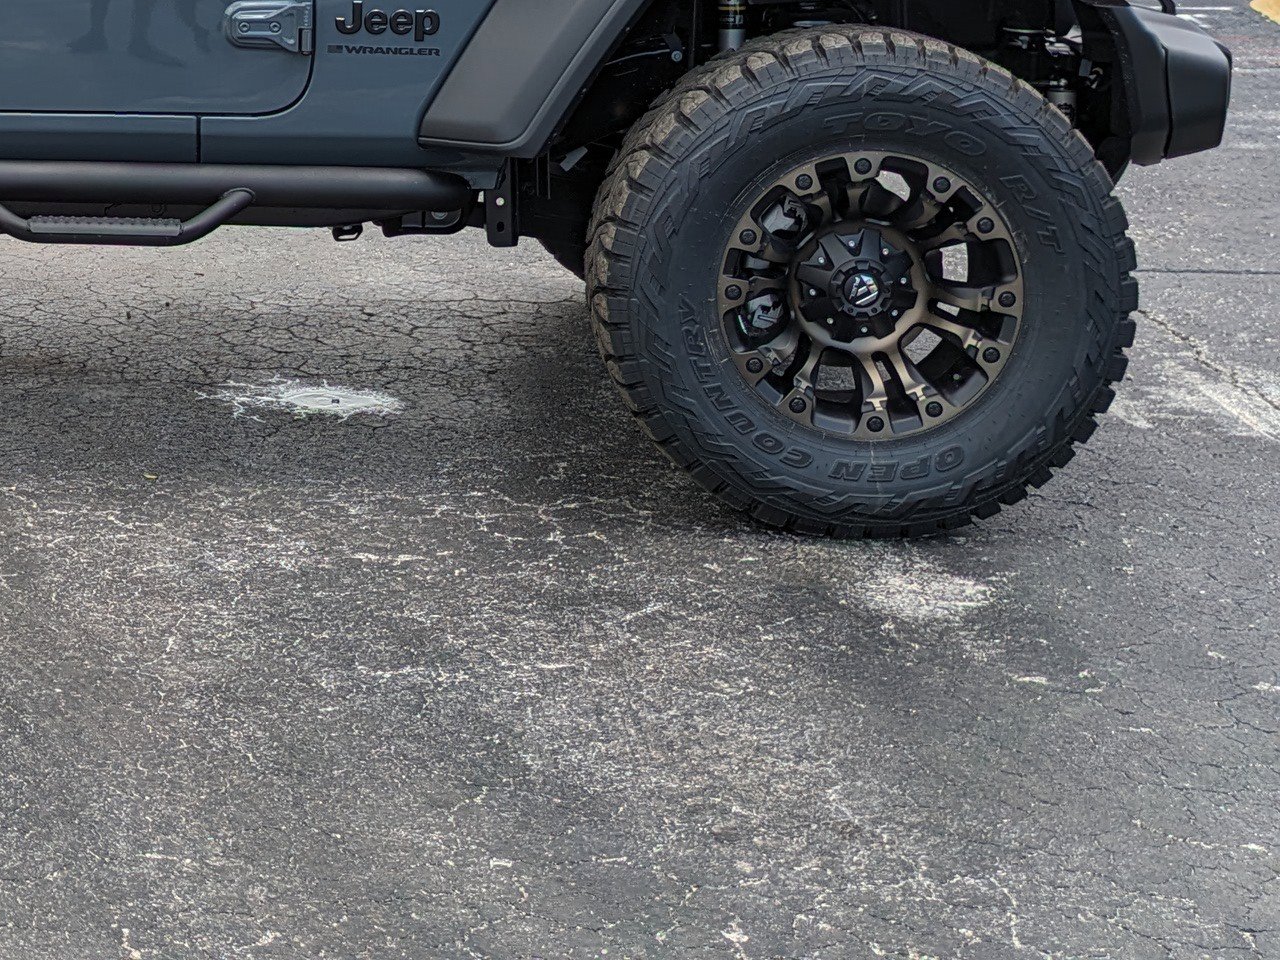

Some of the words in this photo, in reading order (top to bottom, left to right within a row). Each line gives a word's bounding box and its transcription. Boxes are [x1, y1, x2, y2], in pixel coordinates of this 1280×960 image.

[335, 0, 440, 42] Jeep
[344, 45, 441, 57] WRANGLER
[823, 111, 988, 157] TOYO
[678, 293, 815, 469] COUNTRY
[827, 444, 966, 483] OPEN
